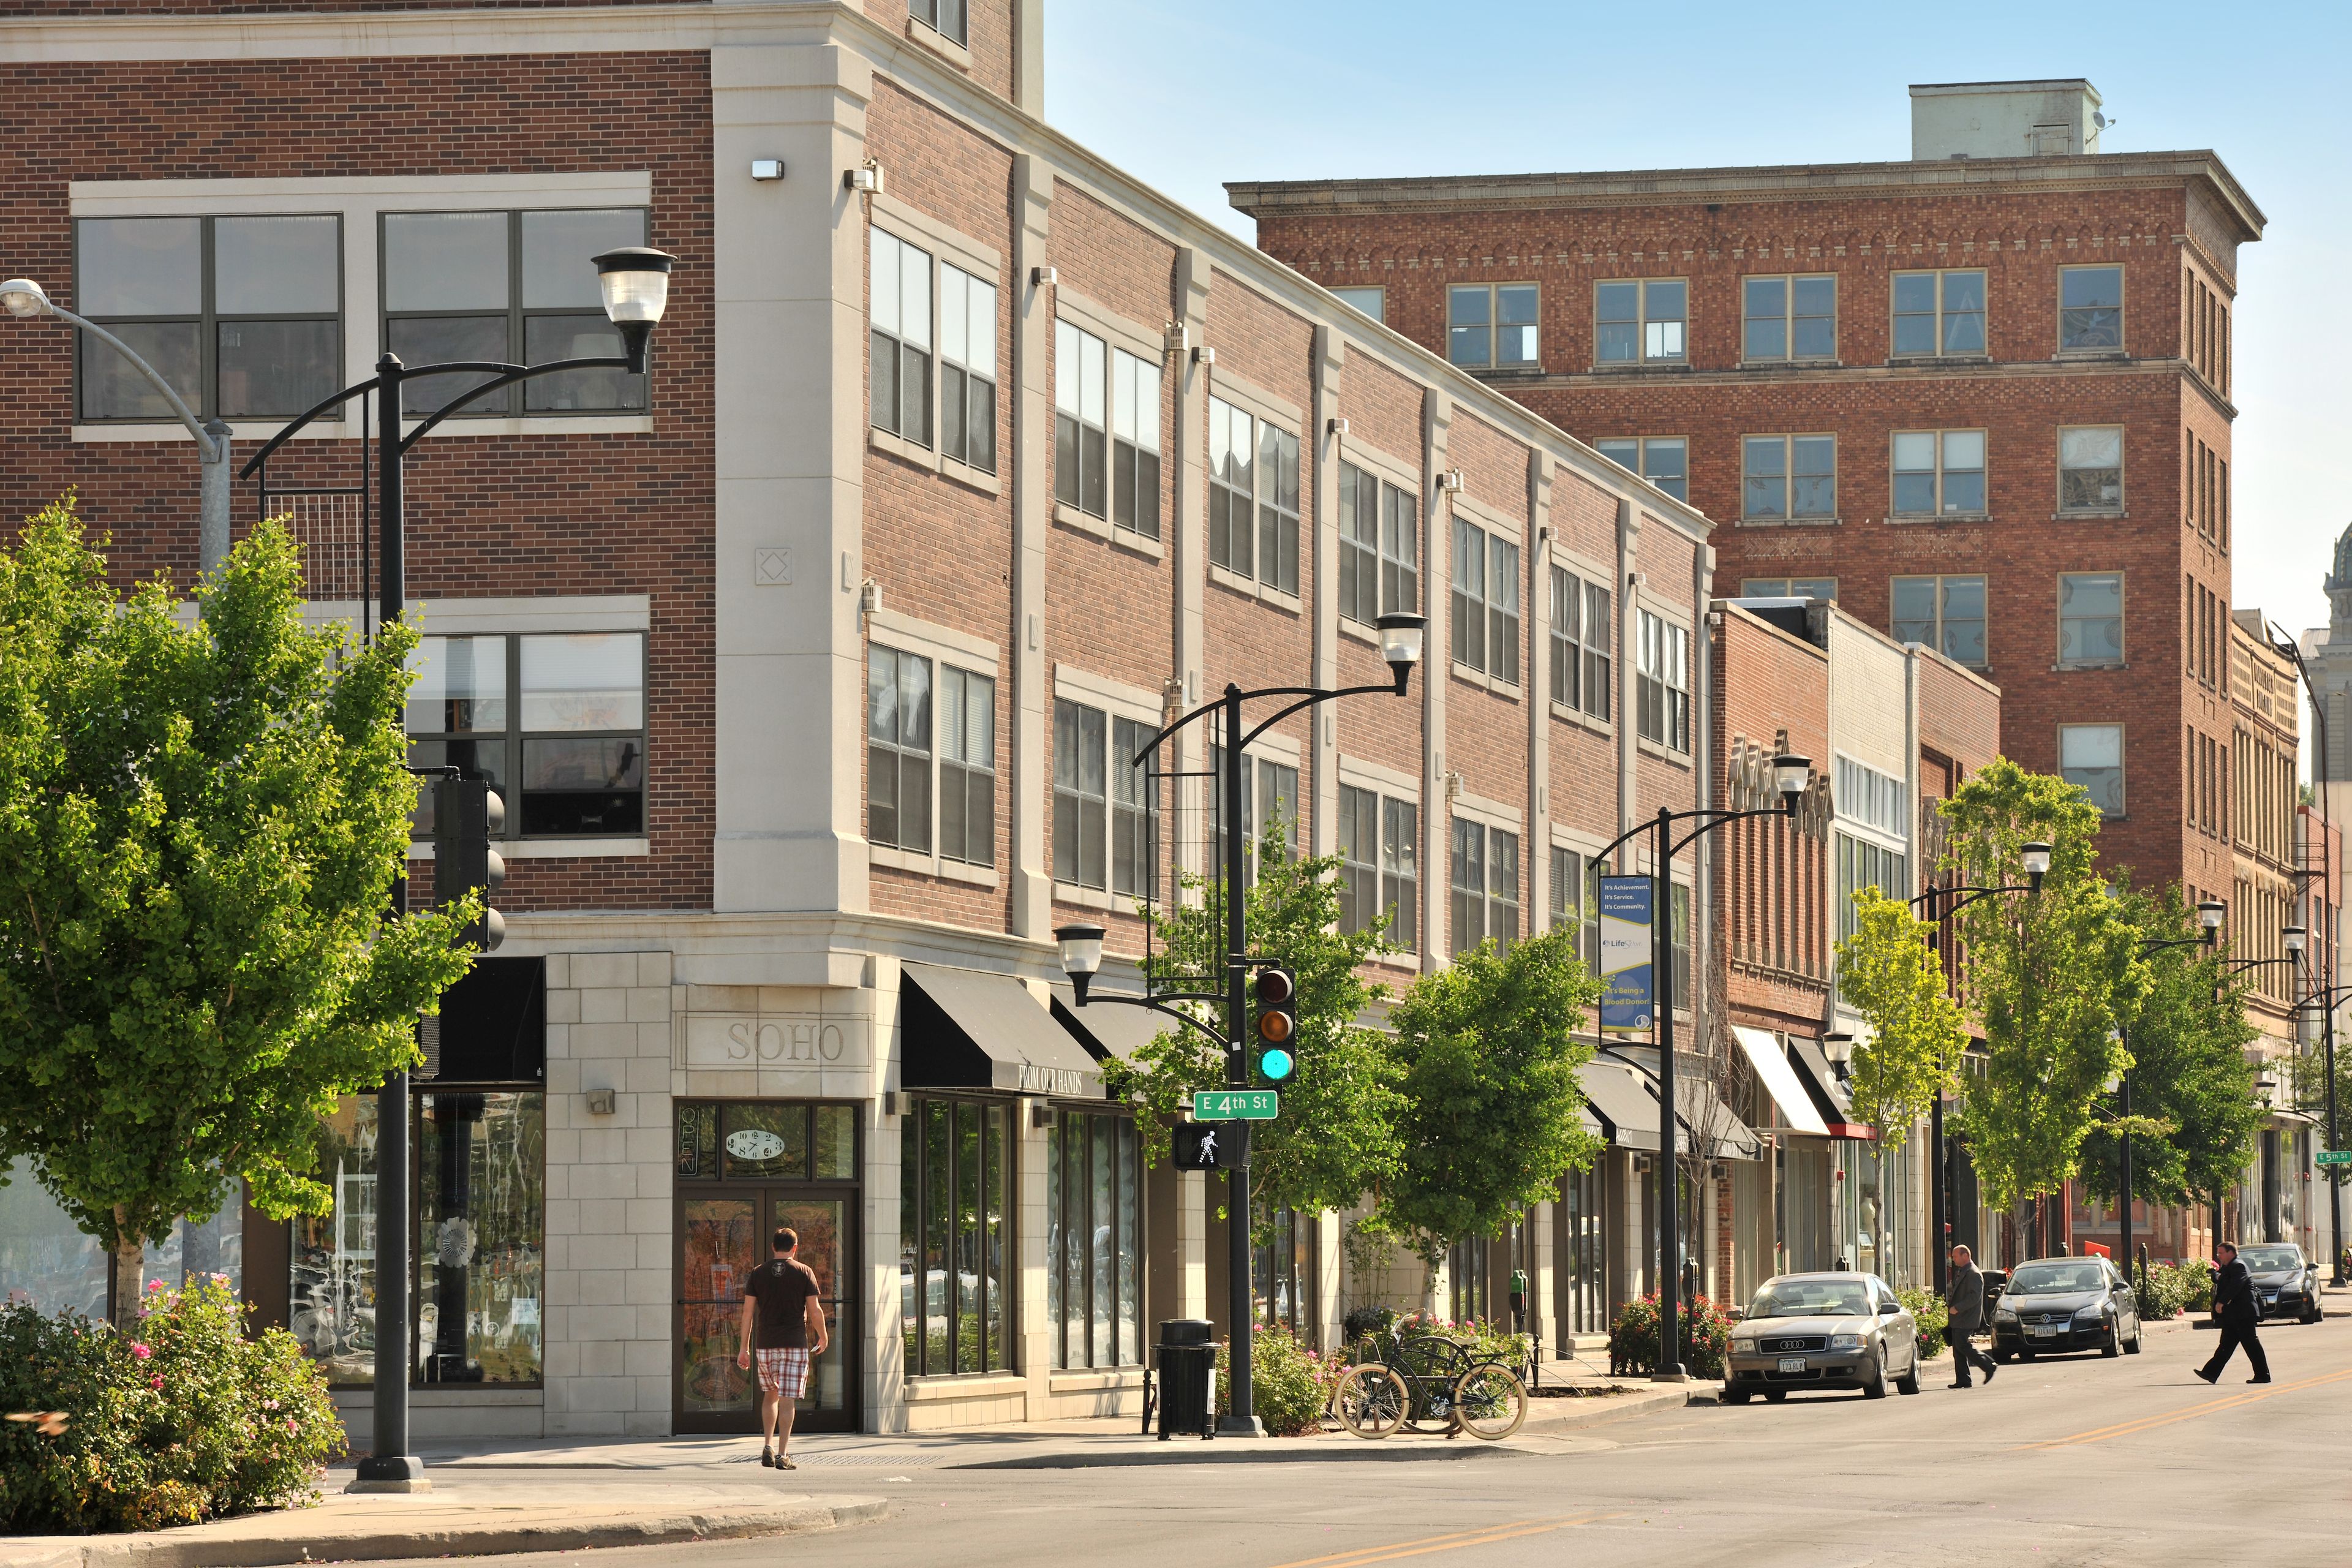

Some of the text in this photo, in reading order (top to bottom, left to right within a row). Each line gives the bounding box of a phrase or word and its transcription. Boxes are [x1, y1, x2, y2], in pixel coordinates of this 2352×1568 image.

[1619, 987, 1638, 995] Being
[727, 1022, 845, 1061] SOHO
[1019, 1065, 1082, 1095] FROM OUR HANDS
[1203, 1095, 1268, 1115] E 4th St
[681, 1107, 696, 1171] OPEN
[765, 1133, 771, 1142] 2
[728, 1139, 734, 1148] 9
[775, 1140, 782, 1151] 3
[739, 1146, 746, 1156] 8
[764, 1147, 772, 1157] 4
[2326, 1153, 2339, 1162] 5th
